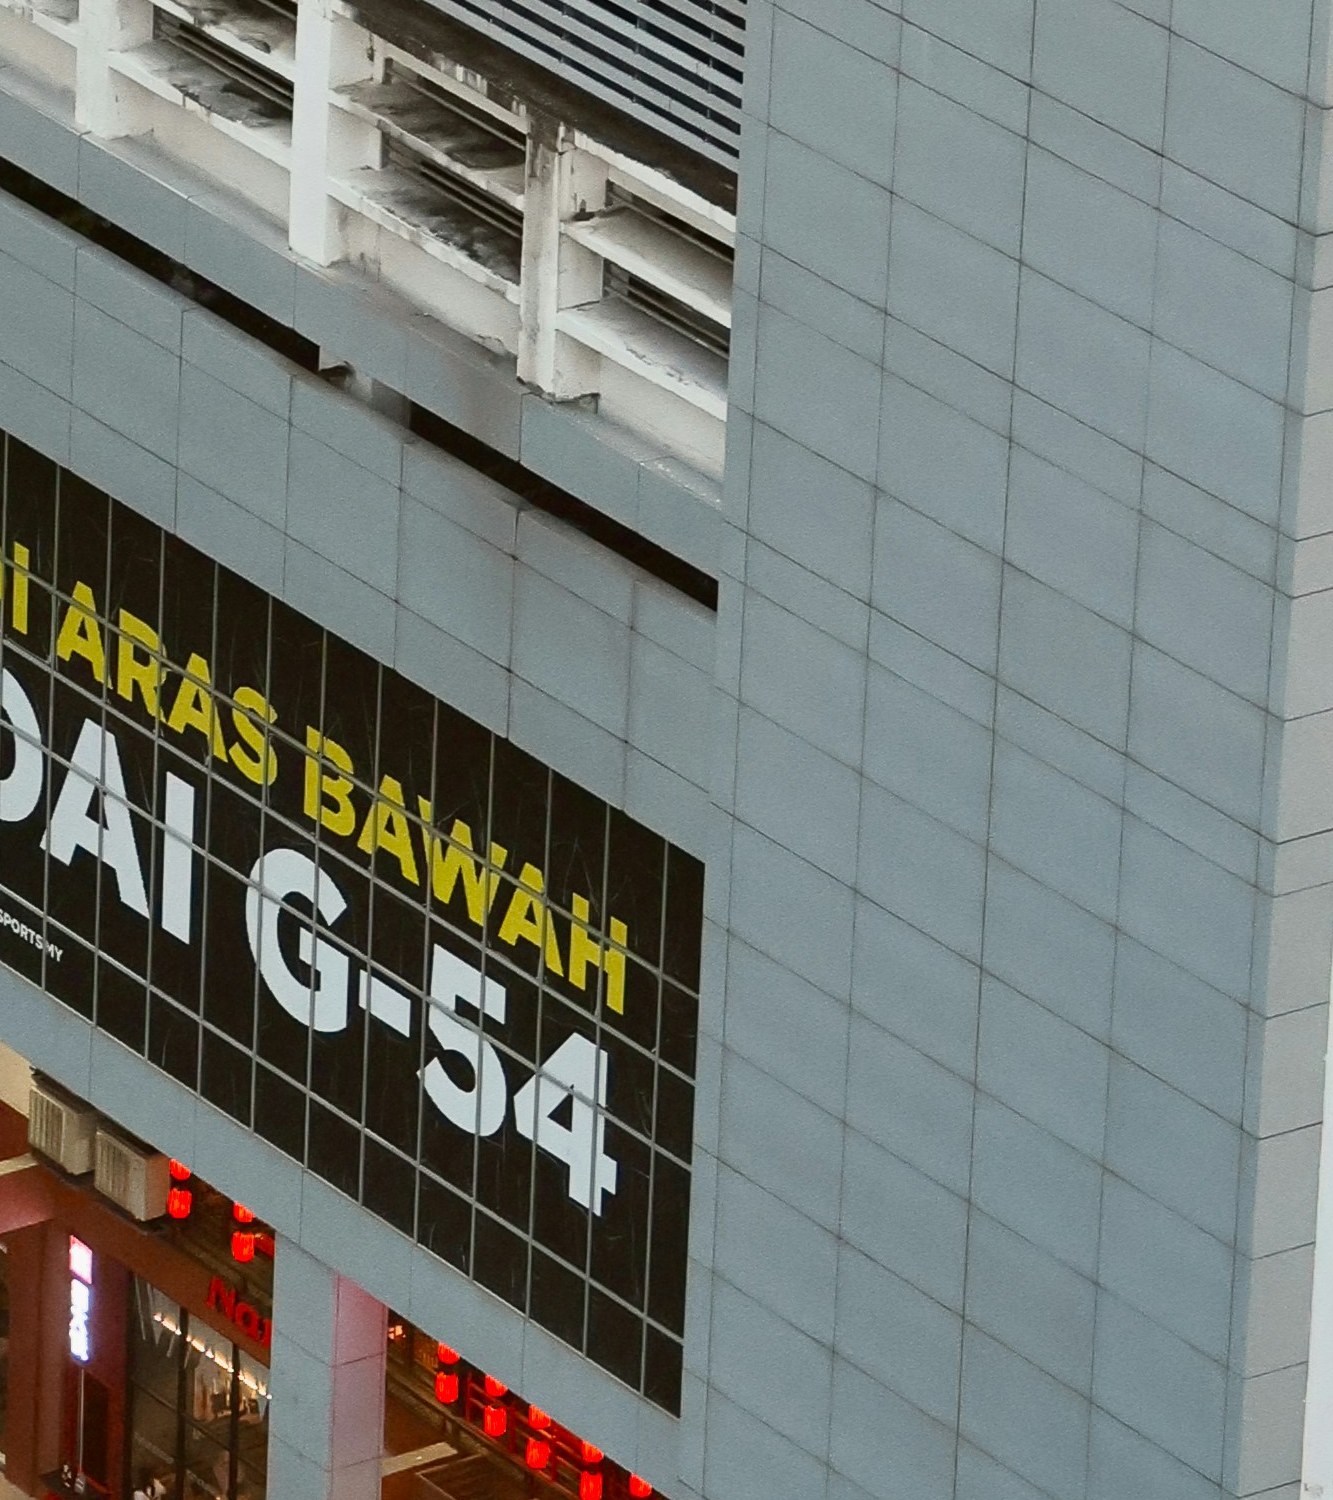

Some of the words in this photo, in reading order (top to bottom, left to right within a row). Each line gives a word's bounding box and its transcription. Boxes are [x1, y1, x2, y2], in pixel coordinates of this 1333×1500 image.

[54, 579, 279, 786] ARAS
[302, 724, 628, 1017] BAWAH
[245, 847, 617, 1218] G-54
